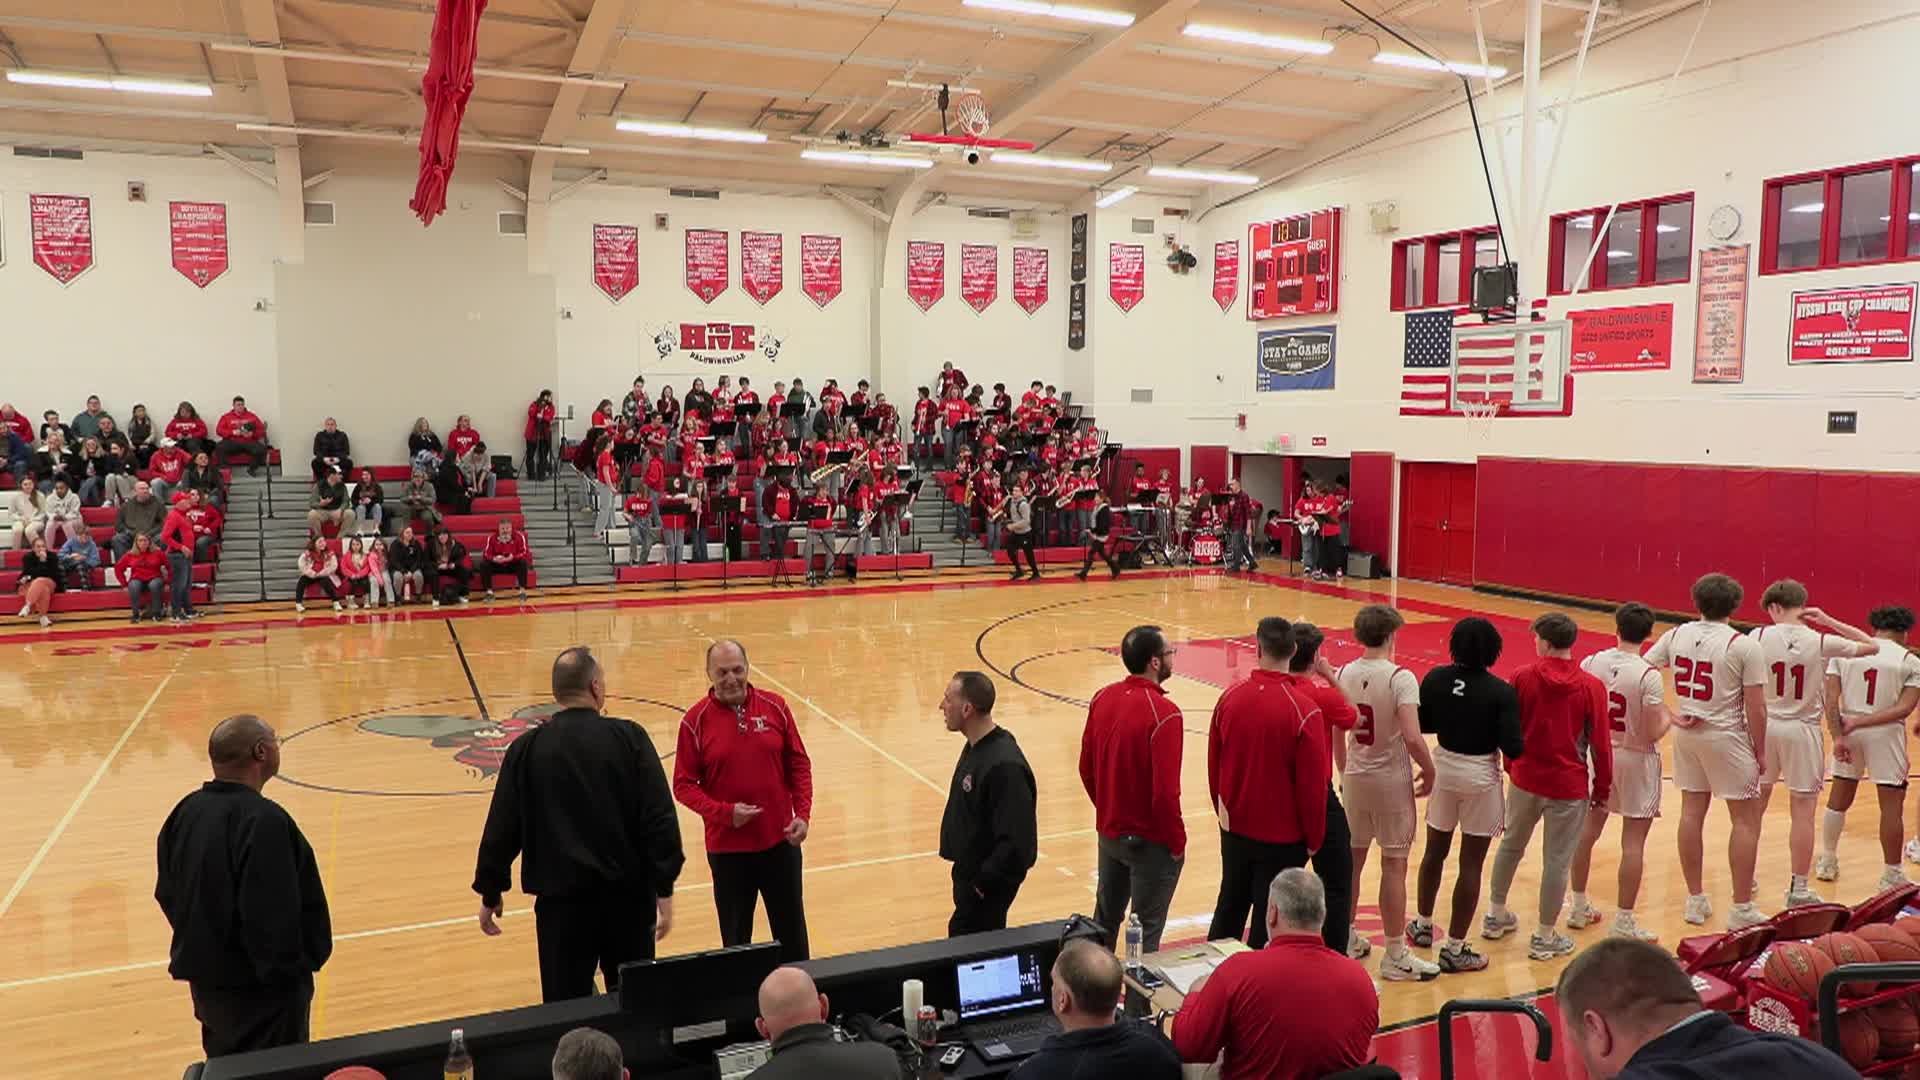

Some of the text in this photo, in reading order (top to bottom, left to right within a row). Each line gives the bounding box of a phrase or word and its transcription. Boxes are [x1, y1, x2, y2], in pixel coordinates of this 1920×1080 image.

[1307, 239, 1327, 252] GUEST
[1255, 249, 1272, 260] HOME
[1320, 250, 1328, 272] 0
[1266, 260, 1274, 280] 0
[1320, 282, 1327, 298] 0
[1257, 291, 1264, 306] 0
[1865, 296, 1910, 312] CHAMPIONS
[1590, 311, 1667, 328] BALDWINSVILLE
[1599, 330, 1625, 342] UNIFIED
[1626, 328, 1654, 341] SPORTS
[689, 351, 746, 364] BALDWINSVILLE
[1264, 346, 1287, 359] STAY
[1298, 343, 1328, 356] GAME
[1674, 655, 1713, 702] 25
[1771, 661, 1805, 700] 11
[1863, 667, 1878, 706] 1
[1452, 679, 1466, 697] 2
